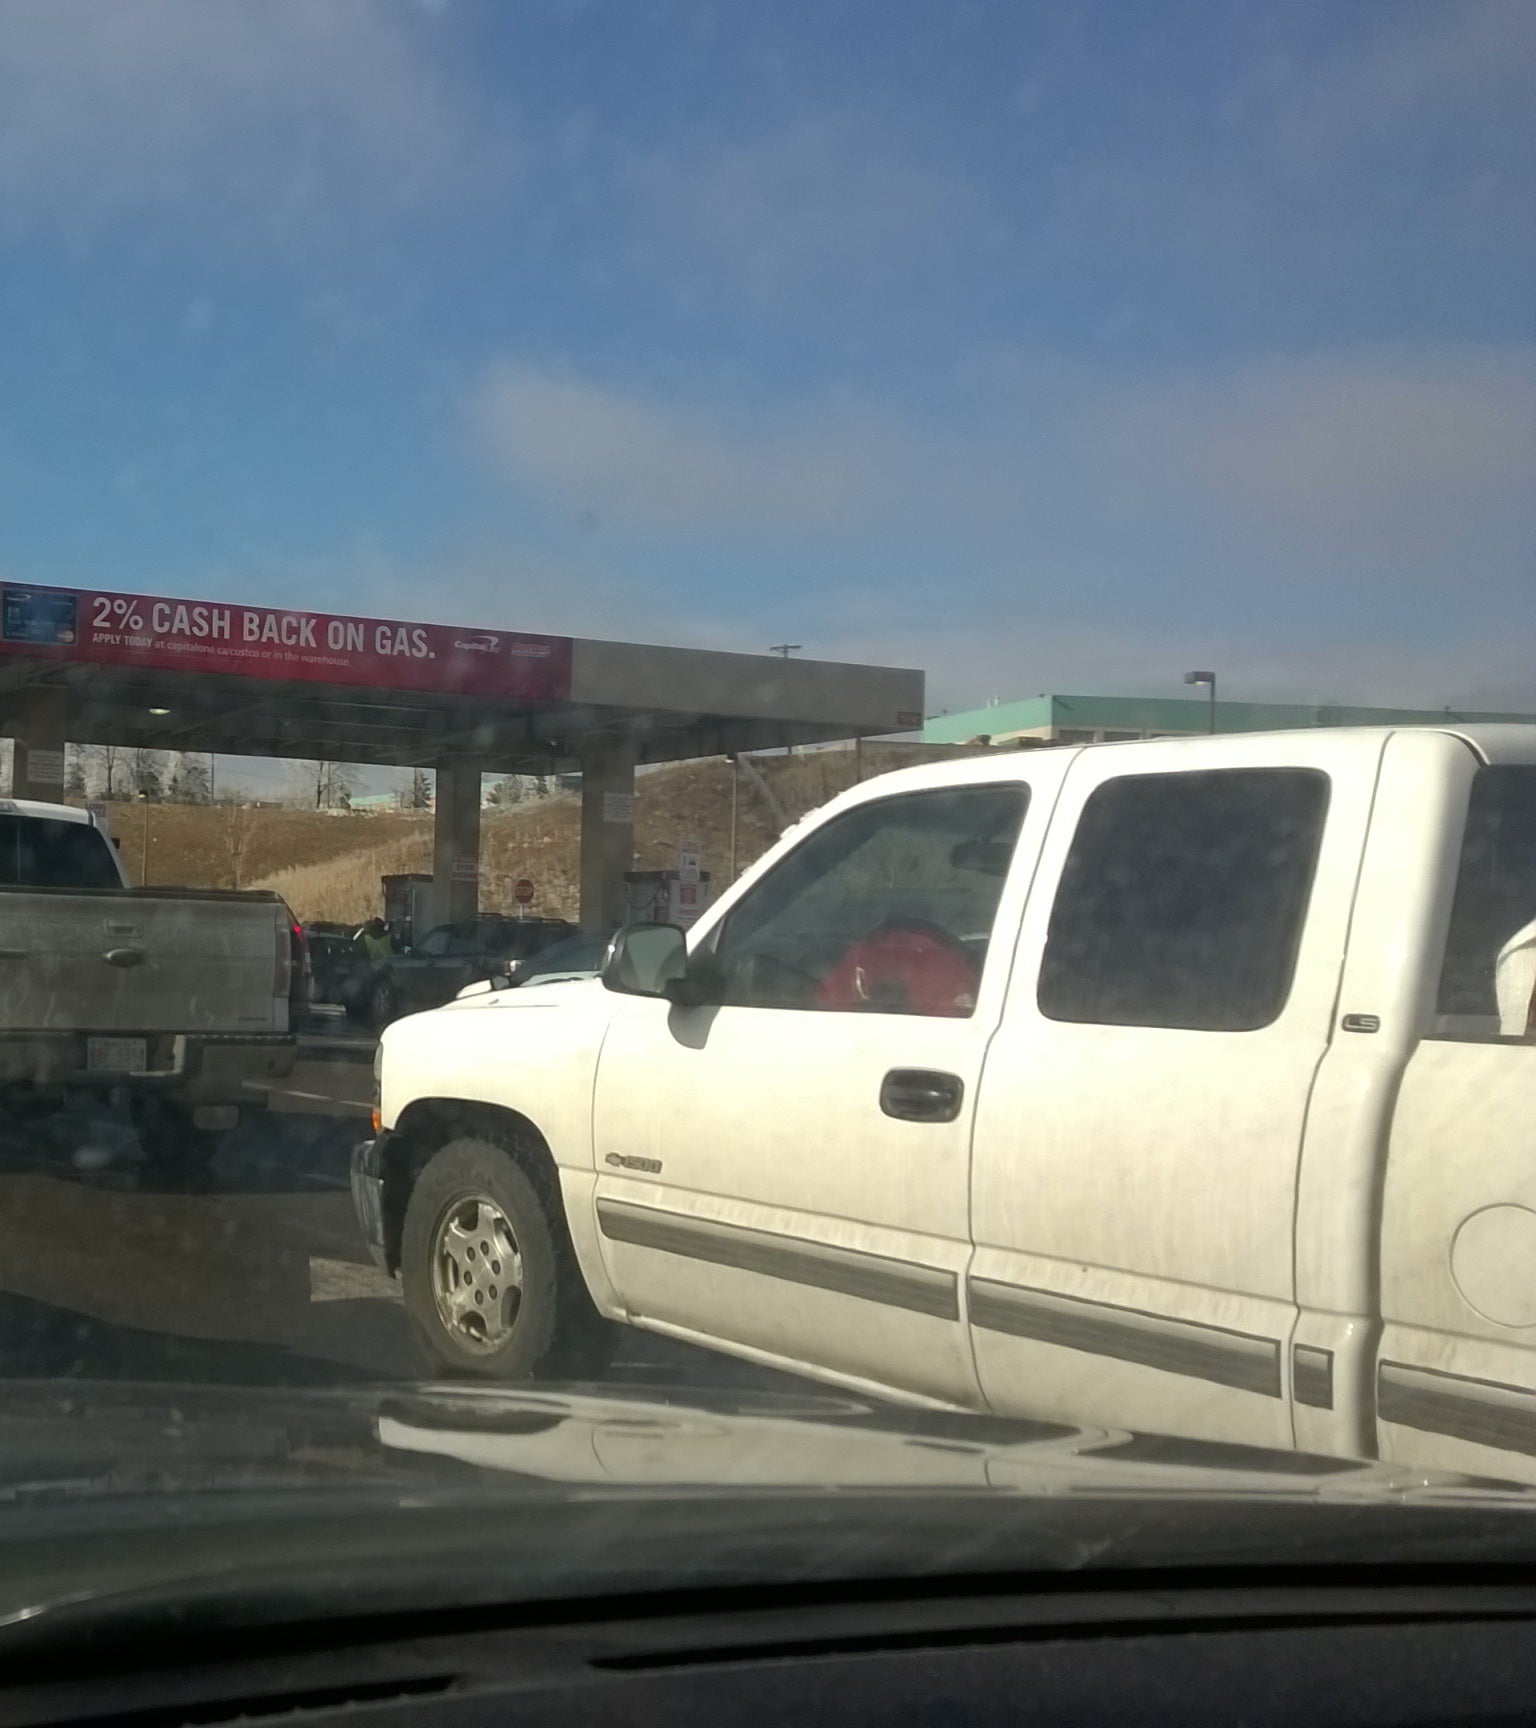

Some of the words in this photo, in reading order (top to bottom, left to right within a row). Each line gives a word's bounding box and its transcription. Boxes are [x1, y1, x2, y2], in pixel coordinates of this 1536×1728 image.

[92, 597, 144, 631] 2%
[152, 602, 231, 640] CASH
[242, 611, 317, 648] BACK
[327, 620, 365, 652] ON
[374, 625, 436, 659] GAS.
[92, 632, 122, 645] APPLY
[123, 635, 153, 648] TODAY
[154, 640, 165, 649] at
[261, 650, 272, 659] or
[273, 651, 284, 660] in
[284, 652, 300, 662] the
